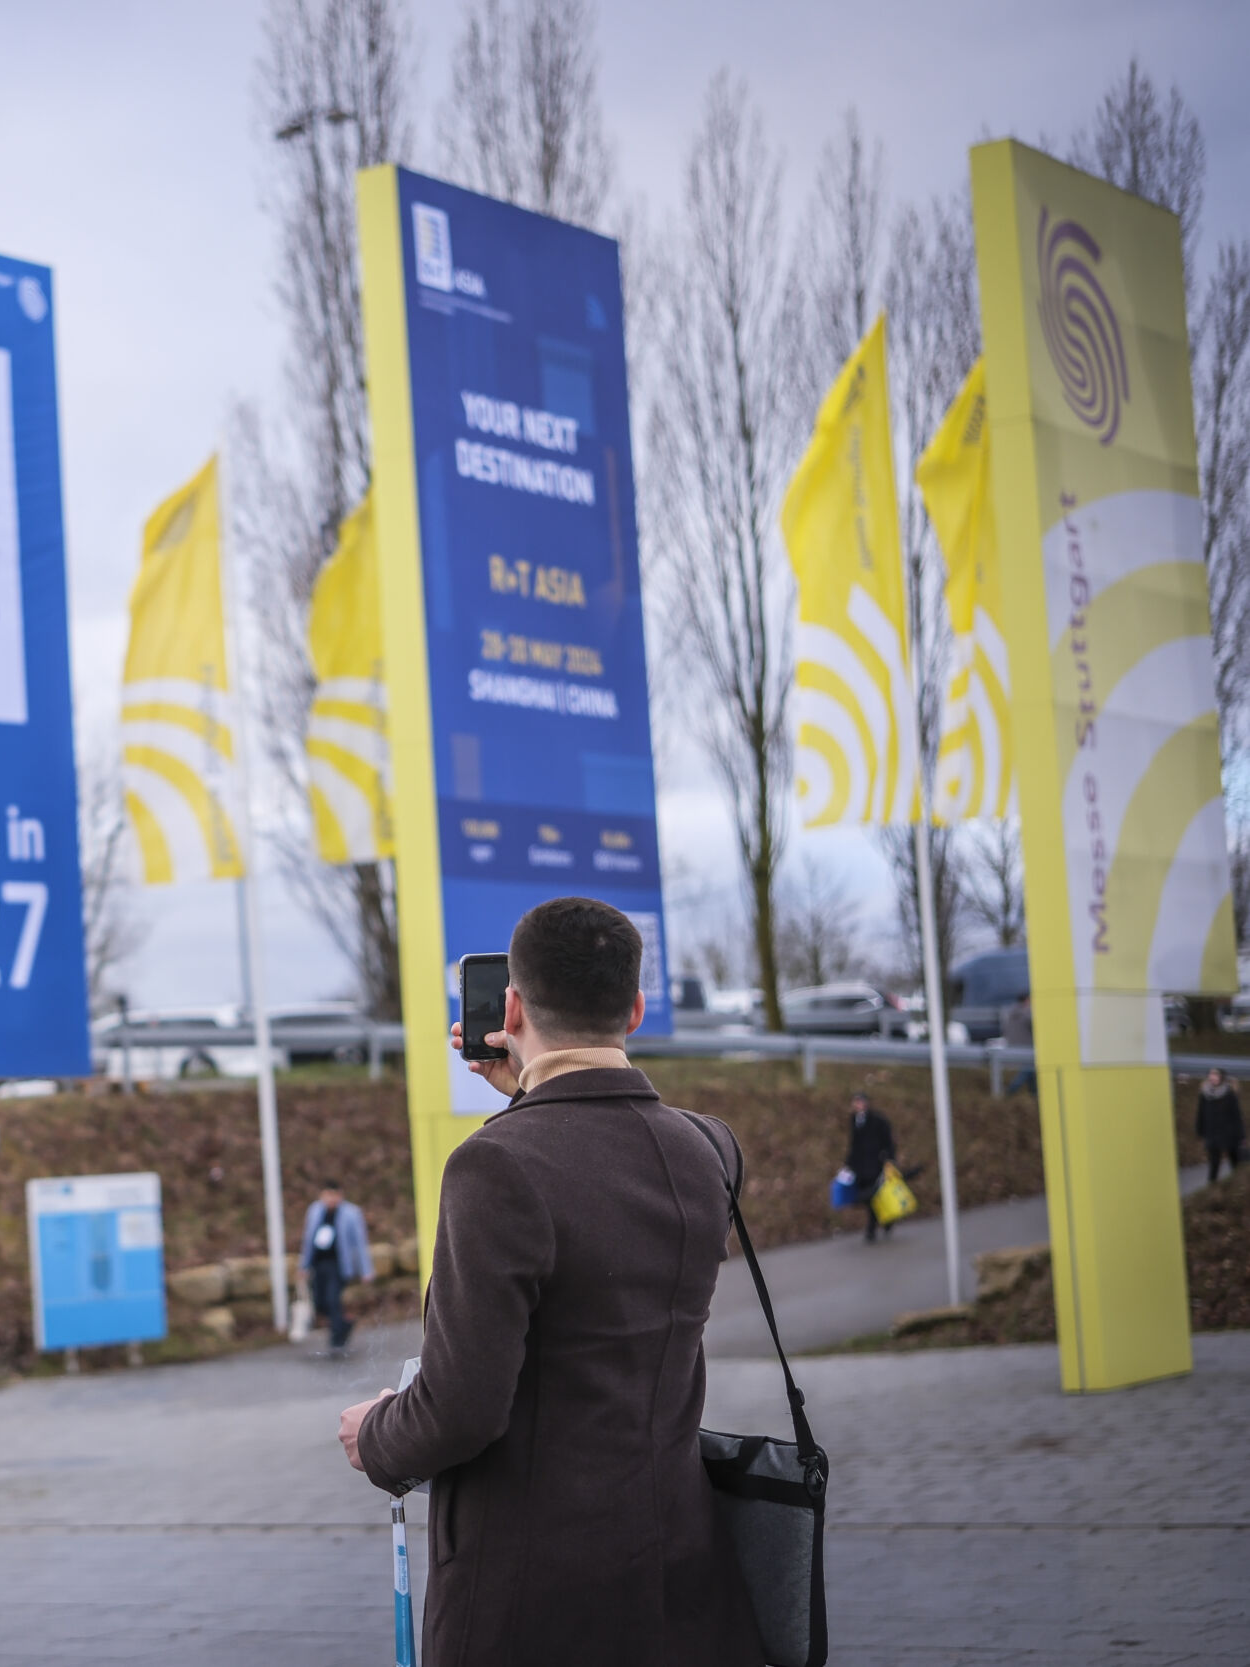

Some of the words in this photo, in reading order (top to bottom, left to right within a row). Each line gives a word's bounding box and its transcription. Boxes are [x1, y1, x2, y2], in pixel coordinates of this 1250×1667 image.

[461, 389, 522, 441] YOUR
[523, 407, 579, 455] NEXT
[455, 438, 595, 507] DESTINATION
[489, 554, 531, 598] R+T
[535, 565, 587, 608] ASIA
[1060, 490, 1096, 749] Stuttgart
[468, 668, 557, 711] SHANGHAI
[566, 683, 619, 720] CHINA
[6, 805, 45, 861] in
[1082, 773, 1111, 955] Messe
